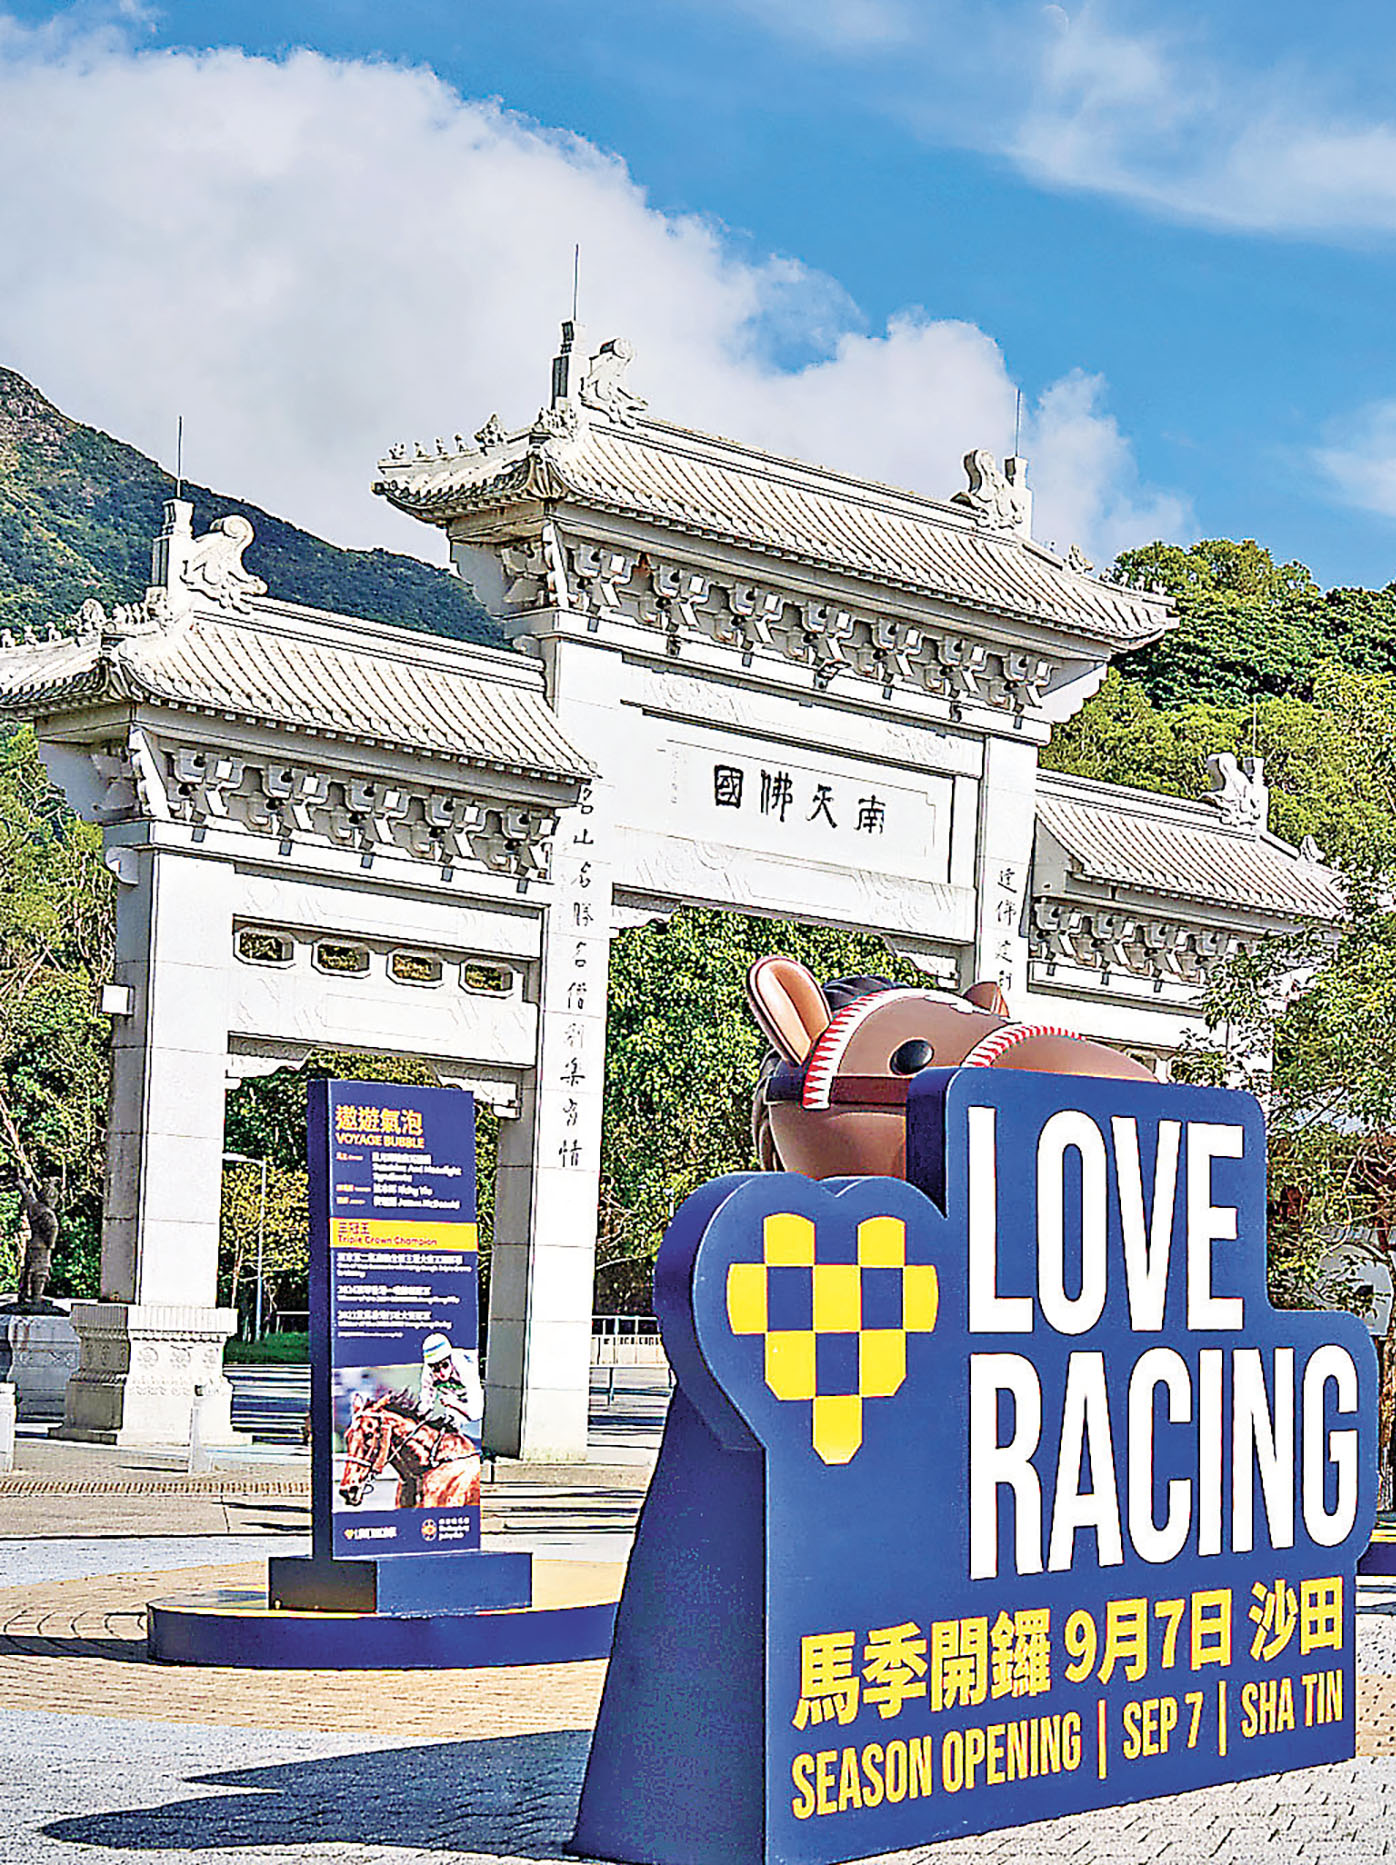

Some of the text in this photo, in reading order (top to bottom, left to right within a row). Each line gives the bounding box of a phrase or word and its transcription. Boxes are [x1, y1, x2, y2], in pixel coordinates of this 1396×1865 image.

[335, 1104, 424, 1136] 遨遊氣泡
[335, 1133, 425, 1150] VOYAGE BUBBLE
[338, 1234, 437, 1247] Triple Crown Champion
[968, 1106, 1243, 1335] LOVE
[969, 1345, 1359, 1580] RACING
[792, 1576, 1343, 1731] 馬季開鑼 9月7日 沙田
[792, 1669, 1343, 1820] SEASON OPENING SEP 7 SHA TIN
